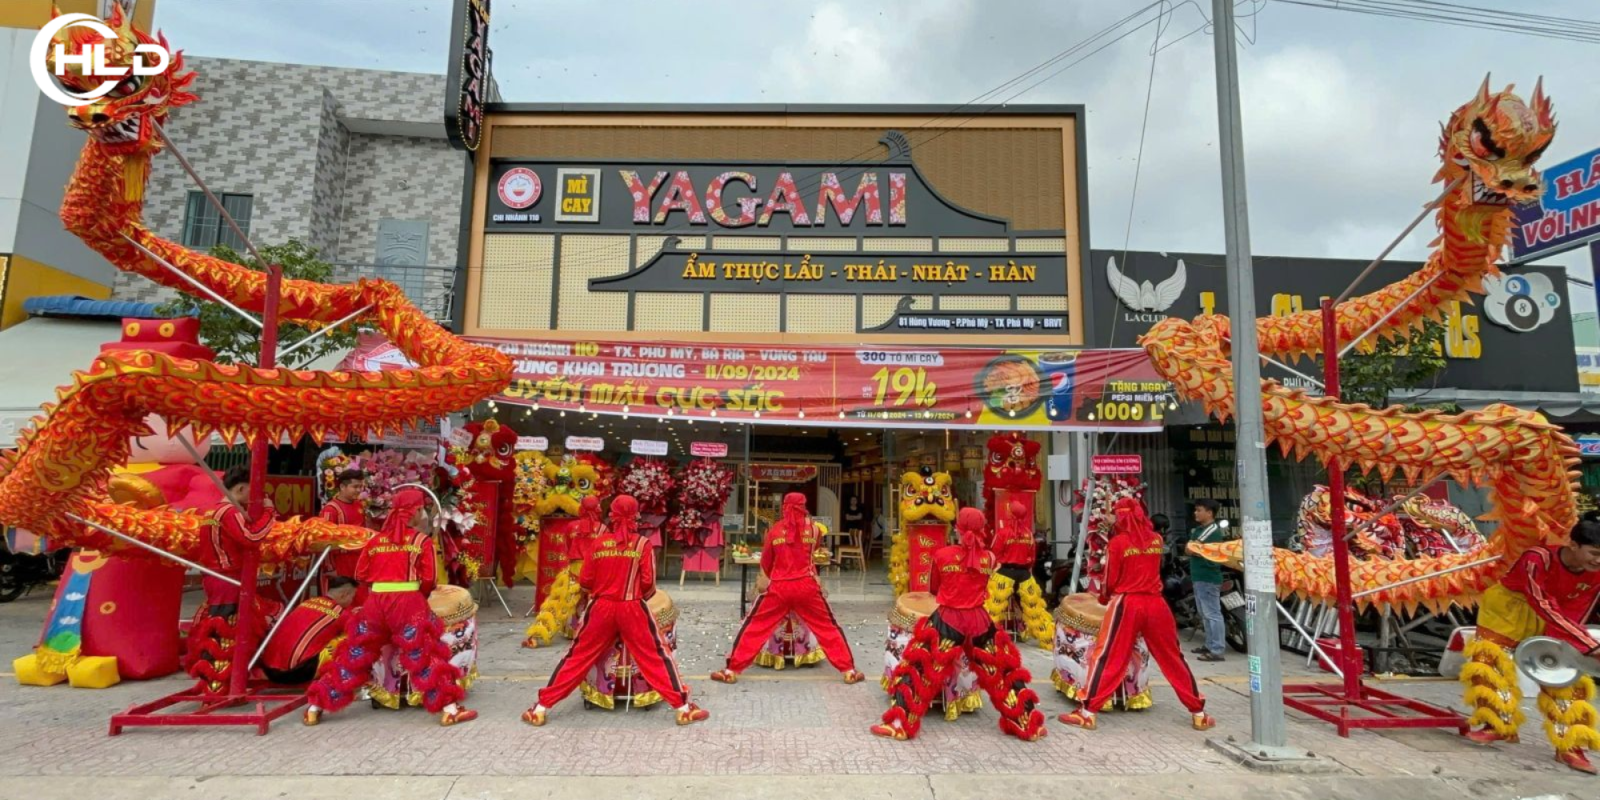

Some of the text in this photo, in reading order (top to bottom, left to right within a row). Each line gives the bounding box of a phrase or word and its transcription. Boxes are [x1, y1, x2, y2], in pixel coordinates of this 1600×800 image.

[567, 175, 588, 194] MÌ
[562, 198, 592, 213] CAY
[618, 170, 907, 226] YAGAMI
[1521, 208, 1567, 248] VỚI
[682, 252, 716, 278] ẨM
[722, 261, 780, 284] THỰC
[784, 254, 824, 280] LẨU
[844, 260, 897, 281] THÁI
[912, 261, 970, 286] NHẬT
[989, 260, 1037, 281] HÀN
[899, 317, 908, 328] 81
[908, 316, 927, 330] Hùng
[995, 318, 1005, 328] TX
[1043, 318, 1063, 328] BRVT
[639, 345, 667, 358] PHÚ
[862, 352, 886, 361] 300
[919, 354, 938, 363] CAY
[563, 361, 605, 376] KHAI
[705, 364, 800, 381] 11/09/2024
[589, 379, 649, 406] MÃI
[656, 385, 719, 413] CỰC
[726, 382, 785, 412] SỐC
[1141, 382, 1167, 392] NGAY
[1111, 393, 1133, 401] PEPSI
[1154, 394, 1167, 402] PH
[1096, 402, 1144, 420] 1000
